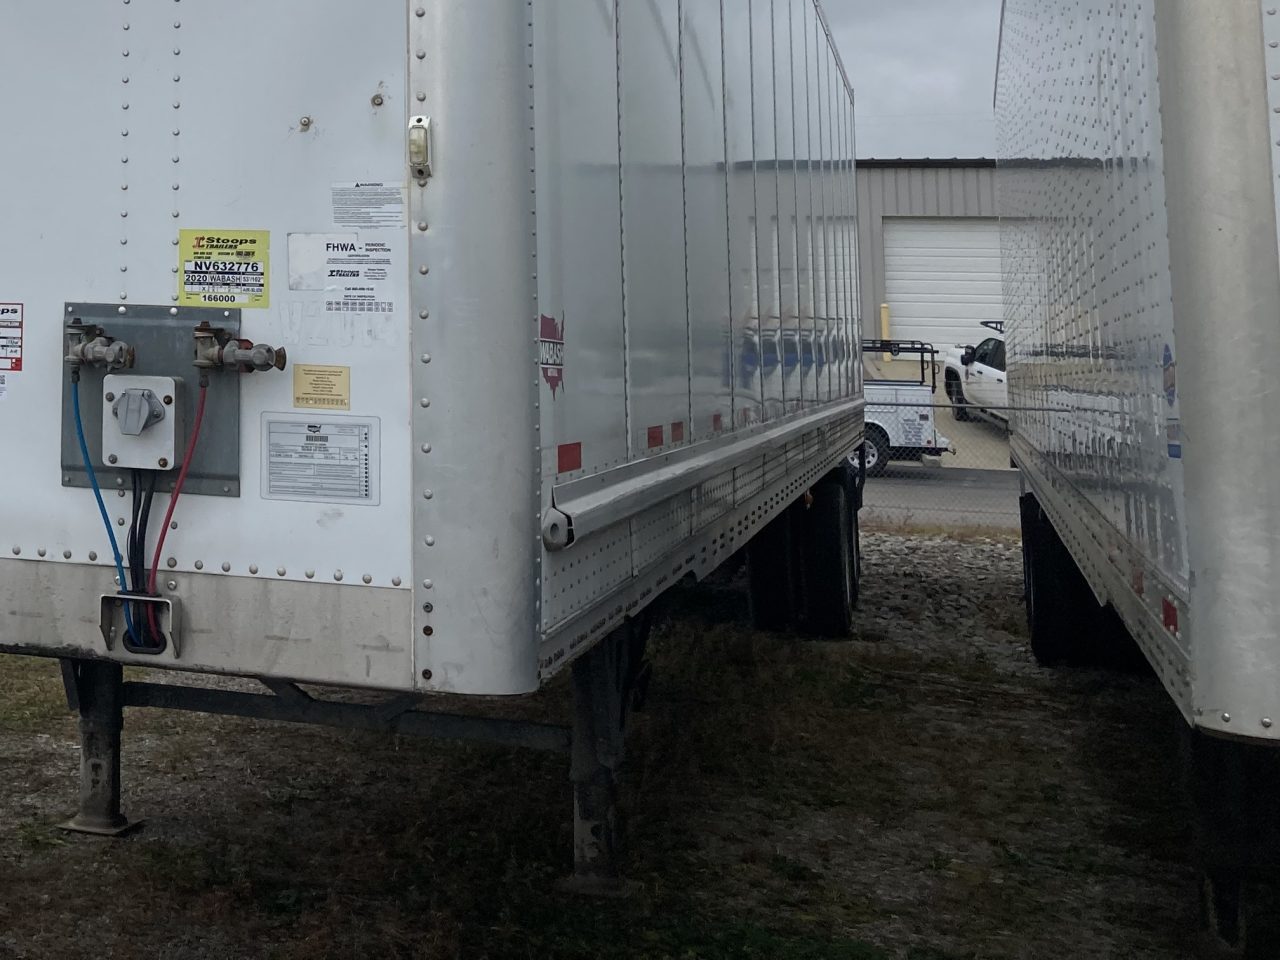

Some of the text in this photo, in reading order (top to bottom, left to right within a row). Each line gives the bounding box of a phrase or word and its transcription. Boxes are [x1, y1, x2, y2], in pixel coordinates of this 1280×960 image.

[205, 236, 257, 245] Stoops
[325, 243, 357, 252] FHWA
[194, 261, 259, 272] NV632776
[185, 274, 208, 282] 2020
[209, 275, 241, 283] WABASH
[202, 294, 236, 303] 166000
